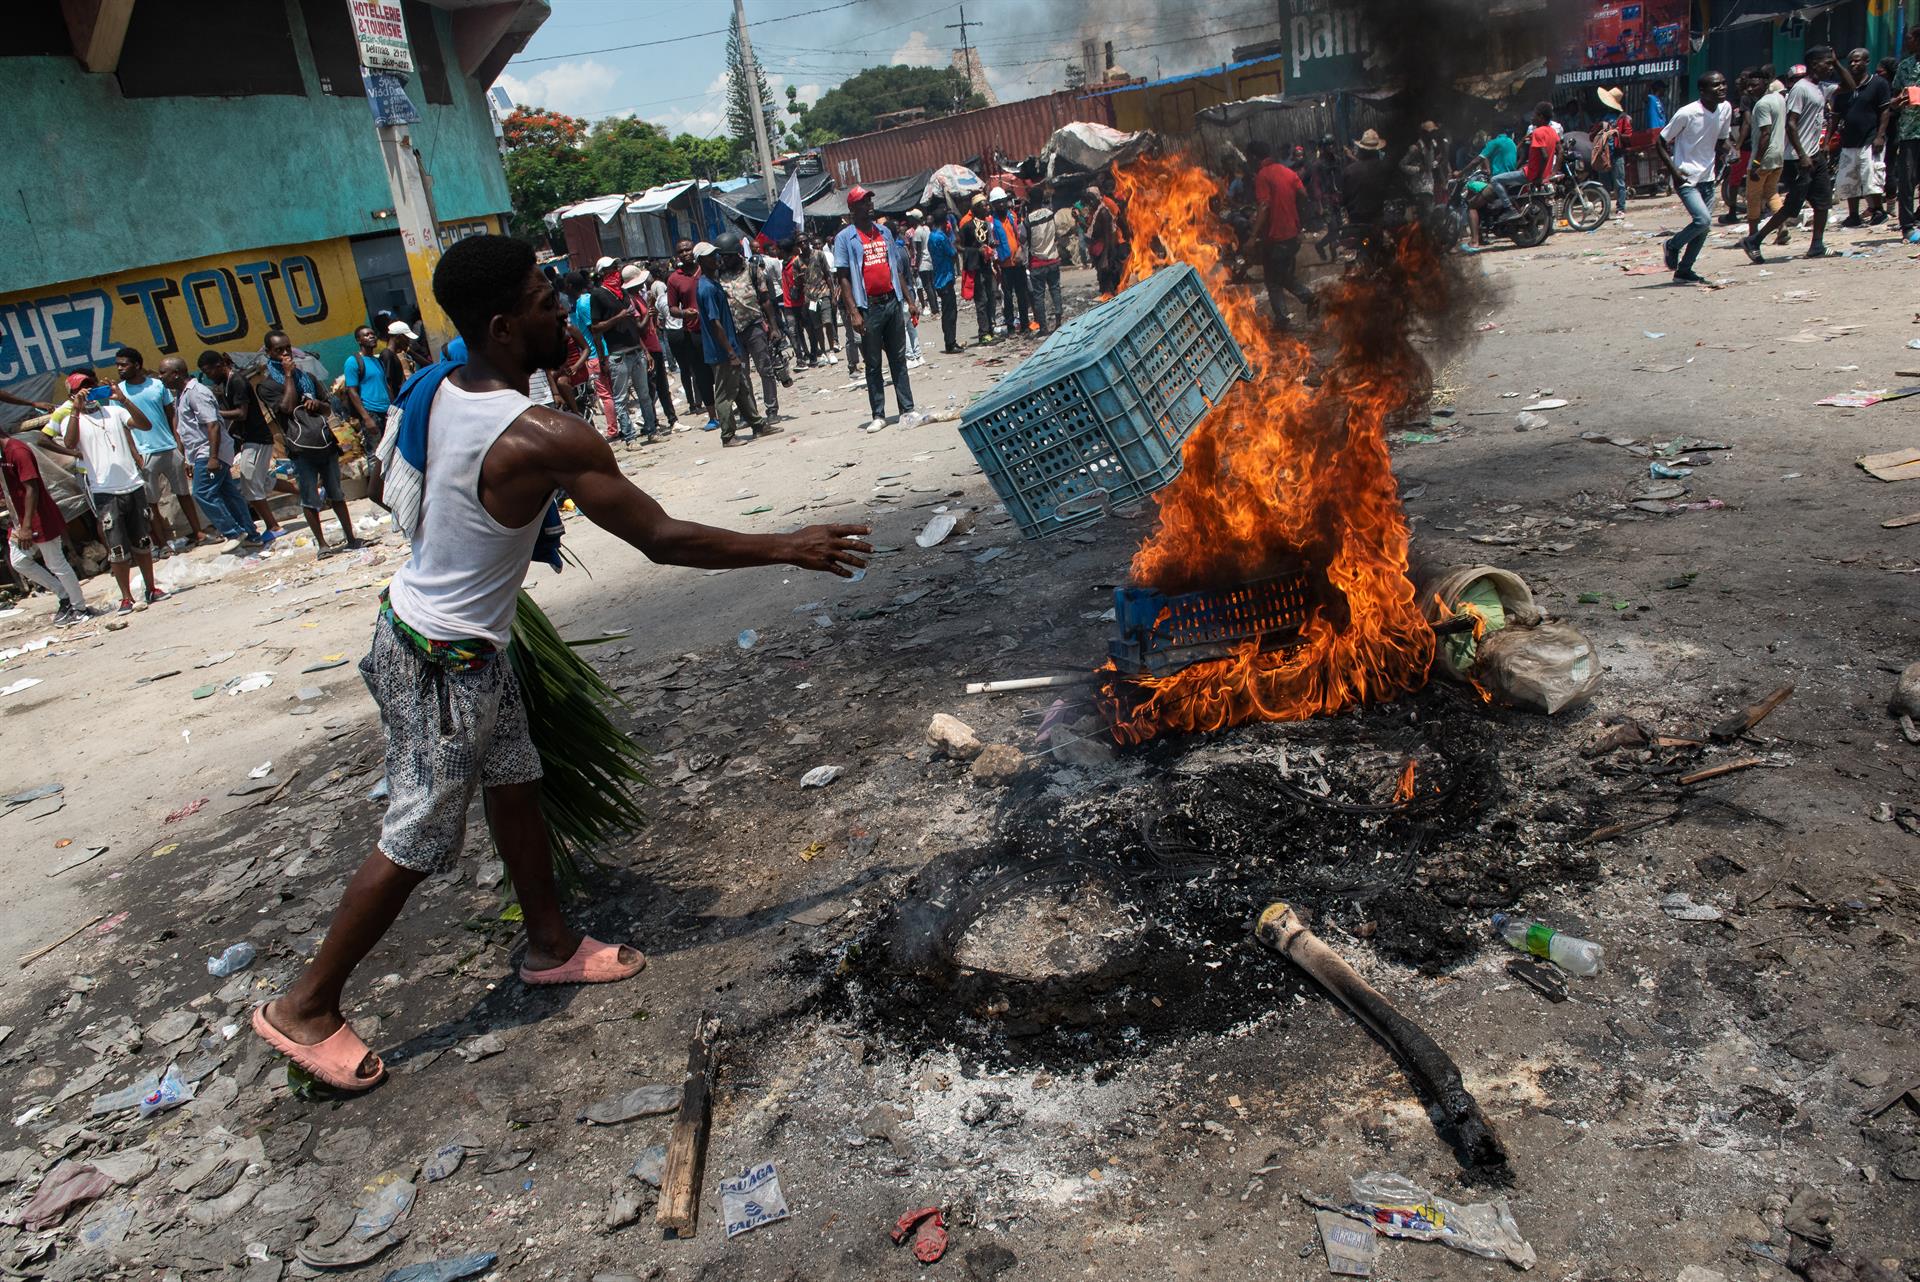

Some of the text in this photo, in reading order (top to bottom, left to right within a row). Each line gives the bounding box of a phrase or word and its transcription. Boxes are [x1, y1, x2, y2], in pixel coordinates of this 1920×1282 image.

[352, 1, 401, 22] HOTELLERIE
[1555, 70, 1593, 84] MEILLEUR
[1594, 67, 1614, 80] PRIX
[1620, 65, 1637, 76] TOP
[1638, 58, 1674, 75] QUALITÉ
[117, 255, 328, 354] TOTO
